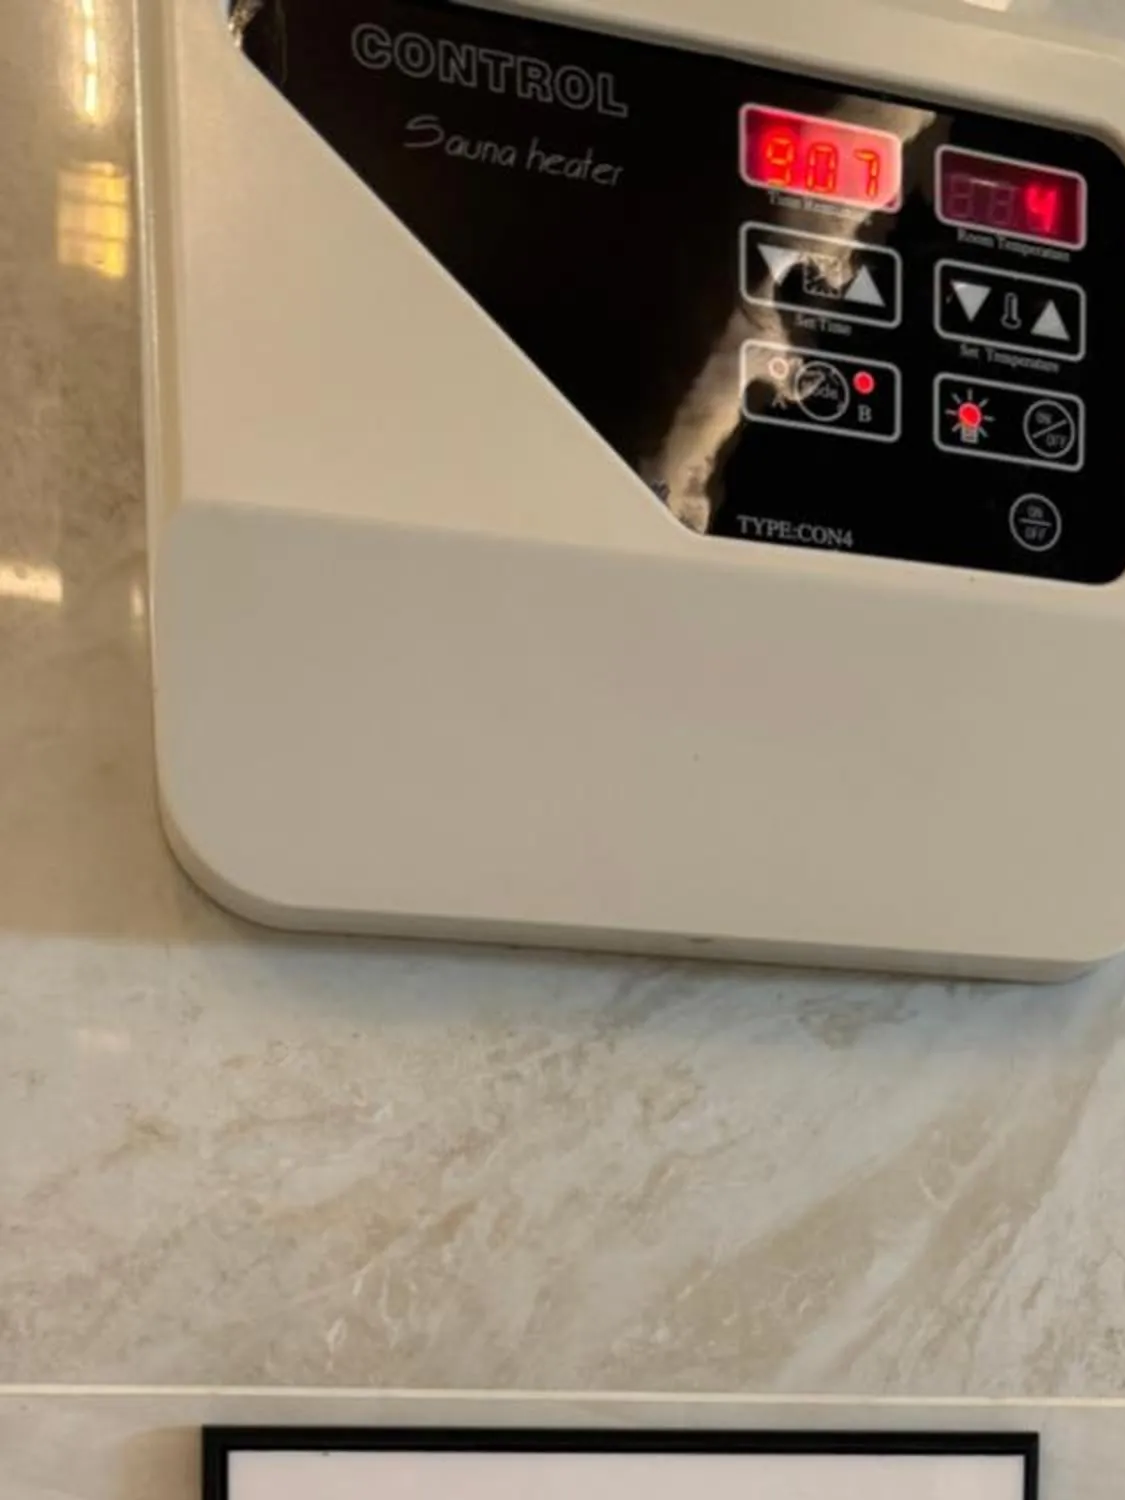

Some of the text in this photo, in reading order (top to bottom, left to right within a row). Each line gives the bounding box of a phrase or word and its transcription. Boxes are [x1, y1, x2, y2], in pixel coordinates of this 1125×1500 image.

[352, 23, 629, 118] CONTROL
[403, 114, 624, 187] Sauna heater
[957, 228, 1071, 263] Room Temperature
[986, 348, 1060, 374] Temperature
